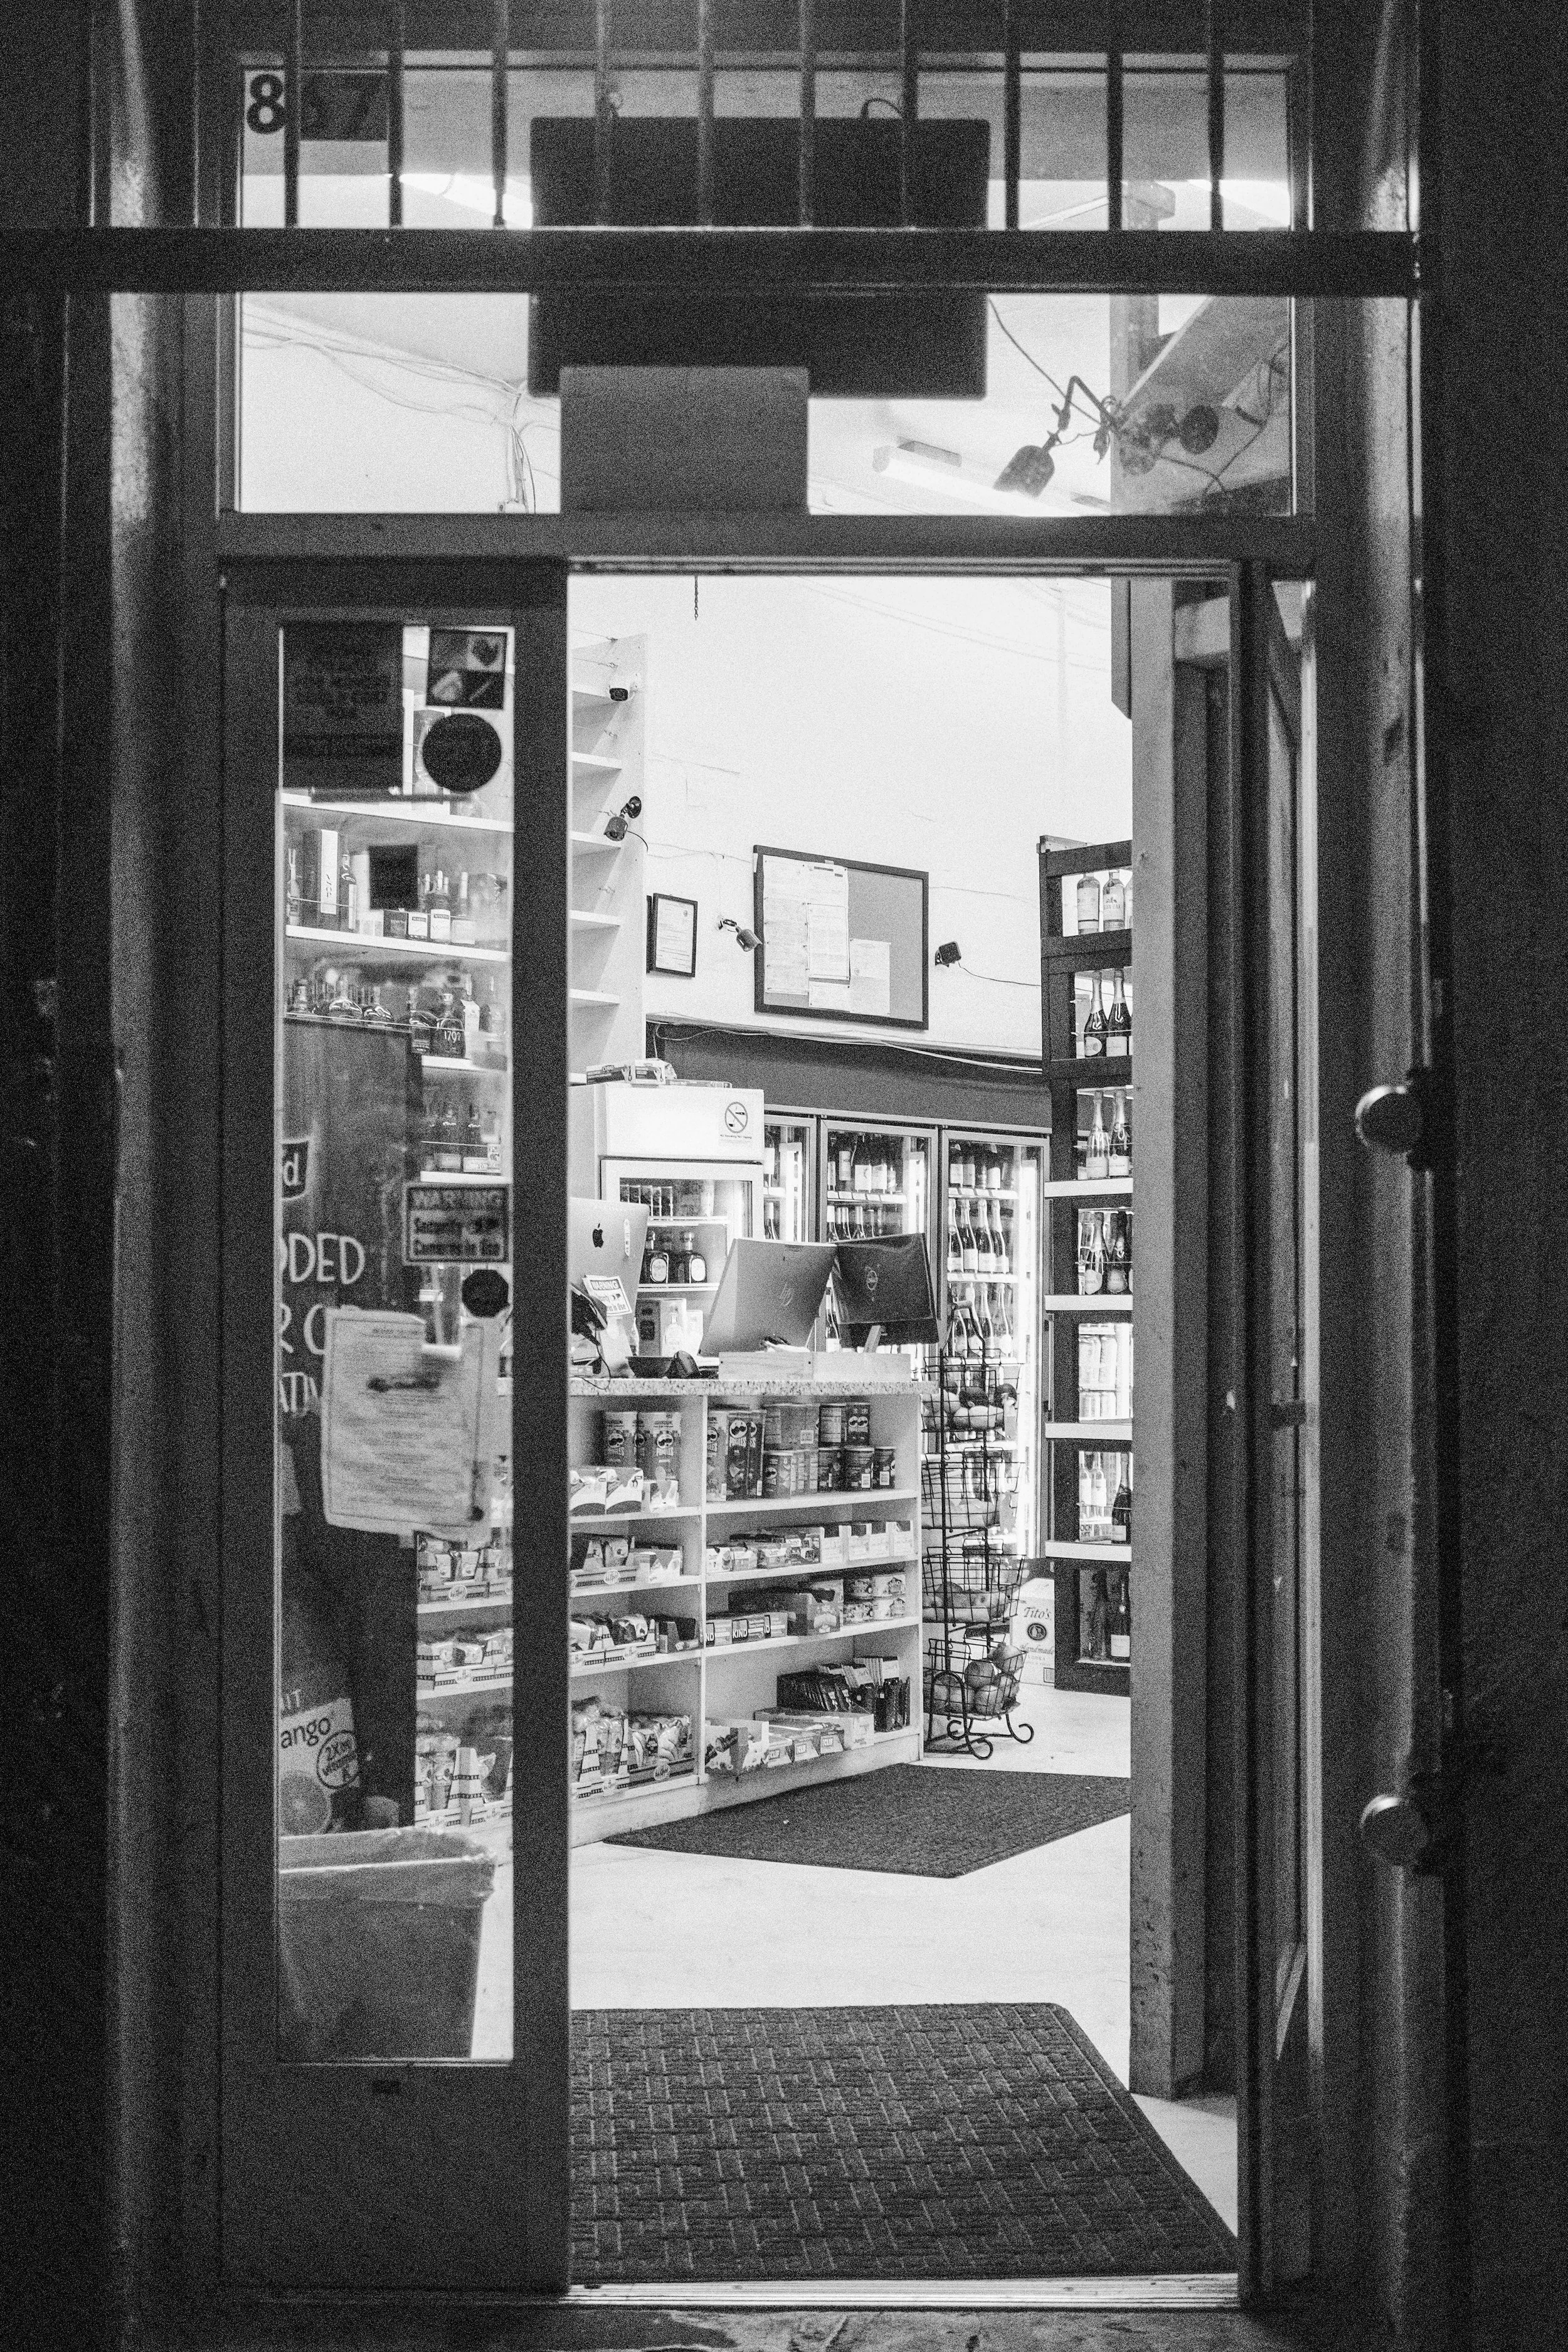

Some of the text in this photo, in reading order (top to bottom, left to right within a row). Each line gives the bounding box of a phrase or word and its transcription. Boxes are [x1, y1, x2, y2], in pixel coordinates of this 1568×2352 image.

[412, 1190, 502, 1208] WARNING
[280, 1232, 366, 1285] DED
[1024, 1606, 1052, 1620] Tito's
[733, 1629, 748, 1639] KIND
[280, 1717, 331, 1749] ango
